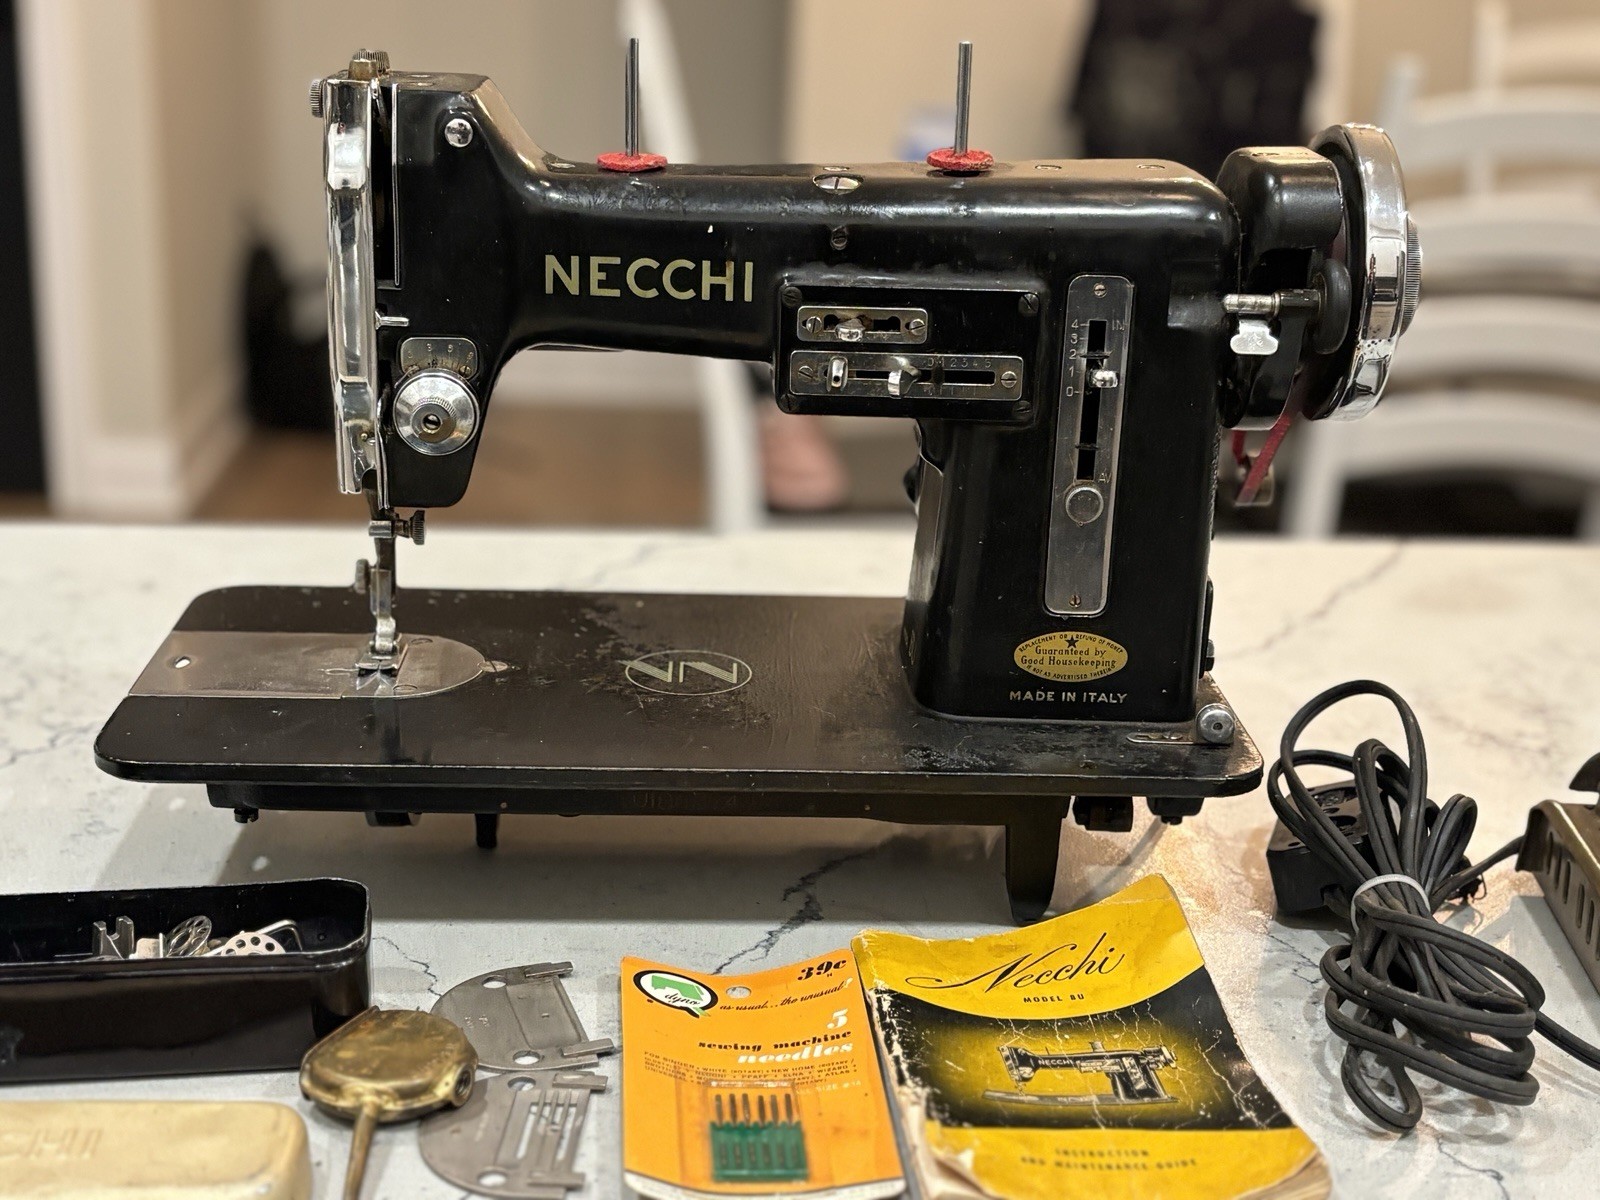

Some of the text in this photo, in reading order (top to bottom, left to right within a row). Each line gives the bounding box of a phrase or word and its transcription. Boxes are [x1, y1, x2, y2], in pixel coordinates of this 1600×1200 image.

[545, 254, 753, 302] NECCHI
[1071, 319, 1079, 329] 4
[1070, 333, 1078, 344] 3
[1069, 349, 1077, 360] 2
[950, 358, 957, 368] 2
[961, 358, 969, 368] 3
[985, 360, 992, 368] 5
[1068, 366, 1075, 378] 1
[1066, 386, 1074, 397] 0
[1018, 635, 1056, 652] REPLACEMENT
[1075, 633, 1097, 642] REFUND
[1035, 645, 1107, 658] Guaranteed by
[1021, 655, 1117, 669] Good Housekeeping
[1009, 690, 1128, 704] MADE IN ITALY
[905, 932, 1125, 993] Necchi
[1023, 993, 1085, 1004] MODEL BU
[826, 1008, 848, 1029] 5
[698, 1031, 852, 1052] sewing machine
[737, 1043, 853, 1064] needles
